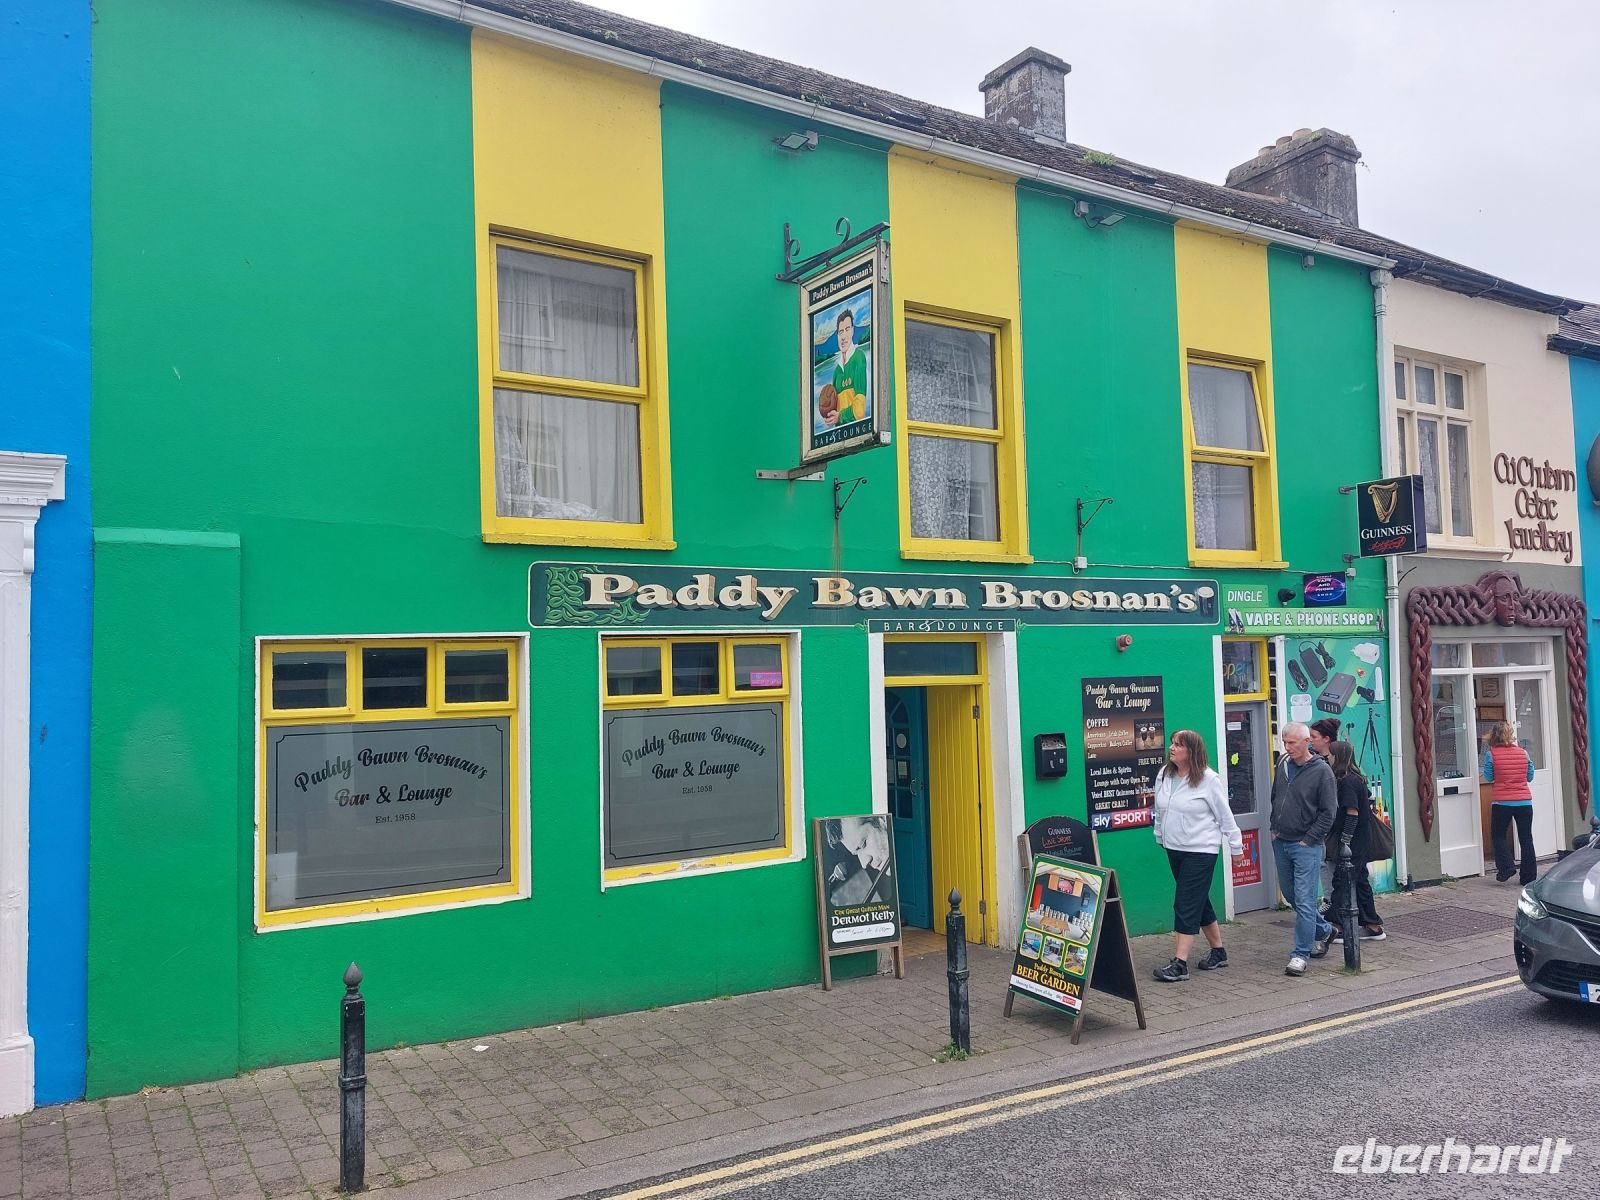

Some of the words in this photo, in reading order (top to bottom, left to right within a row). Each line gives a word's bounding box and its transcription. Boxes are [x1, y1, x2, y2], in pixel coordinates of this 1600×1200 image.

[812, 286, 829, 301] Paddy
[829, 280, 845, 293] Bawn
[844, 264, 873, 286] Brosnan's
[815, 434, 829, 447] BAR
[838, 422, 872, 440] LOUNGE
[1361, 525, 1413, 540] GUINNESS
[583, 573, 799, 621] Paddy
[810, 577, 970, 611] Bawn
[980, 581, 1199, 613] Brosnan's
[1227, 590, 1263, 602] DINGLE
[883, 622, 915, 631] BAR
[919, 620, 943, 632] &
[937, 622, 1004, 632] LOUNGE
[1246, 612, 1281, 626] VAPE
[1284, 613, 1294, 626] &
[1297, 612, 1340, 626] PHONE
[1342, 612, 1374, 626] SHOP
[1096, 696, 1113, 709] Bar
[1123, 694, 1152, 712] Lounge
[1086, 718, 1109, 730] COFFEE
[622, 735, 666, 767] Paddy
[668, 728, 708, 746] Bawn
[710, 726, 767, 757] Brosnan's
[294, 756, 353, 793] Paddy
[357, 748, 410, 767] Bawn
[414, 745, 488, 780] Brosnan's
[651, 763, 679, 780] Bar
[682, 761, 695, 778] &
[698, 759, 741, 780] Lounge
[334, 788, 371, 808] Bar
[375, 785, 392, 804] &
[397, 783, 453, 807] Lounge
[682, 787, 696, 795] Est.
[697, 784, 713, 793] 1958
[375, 814, 393, 824] Est.
[395, 813, 416, 823] 1958
[1094, 814, 1110, 828] sky
[1114, 811, 1148, 825] SPORT
[1047, 827, 1072, 836] GUINNESS
[871, 910, 895, 922] Kelly
[1017, 964, 1039, 982] BEER
[1040, 973, 1081, 998] GARDEN
